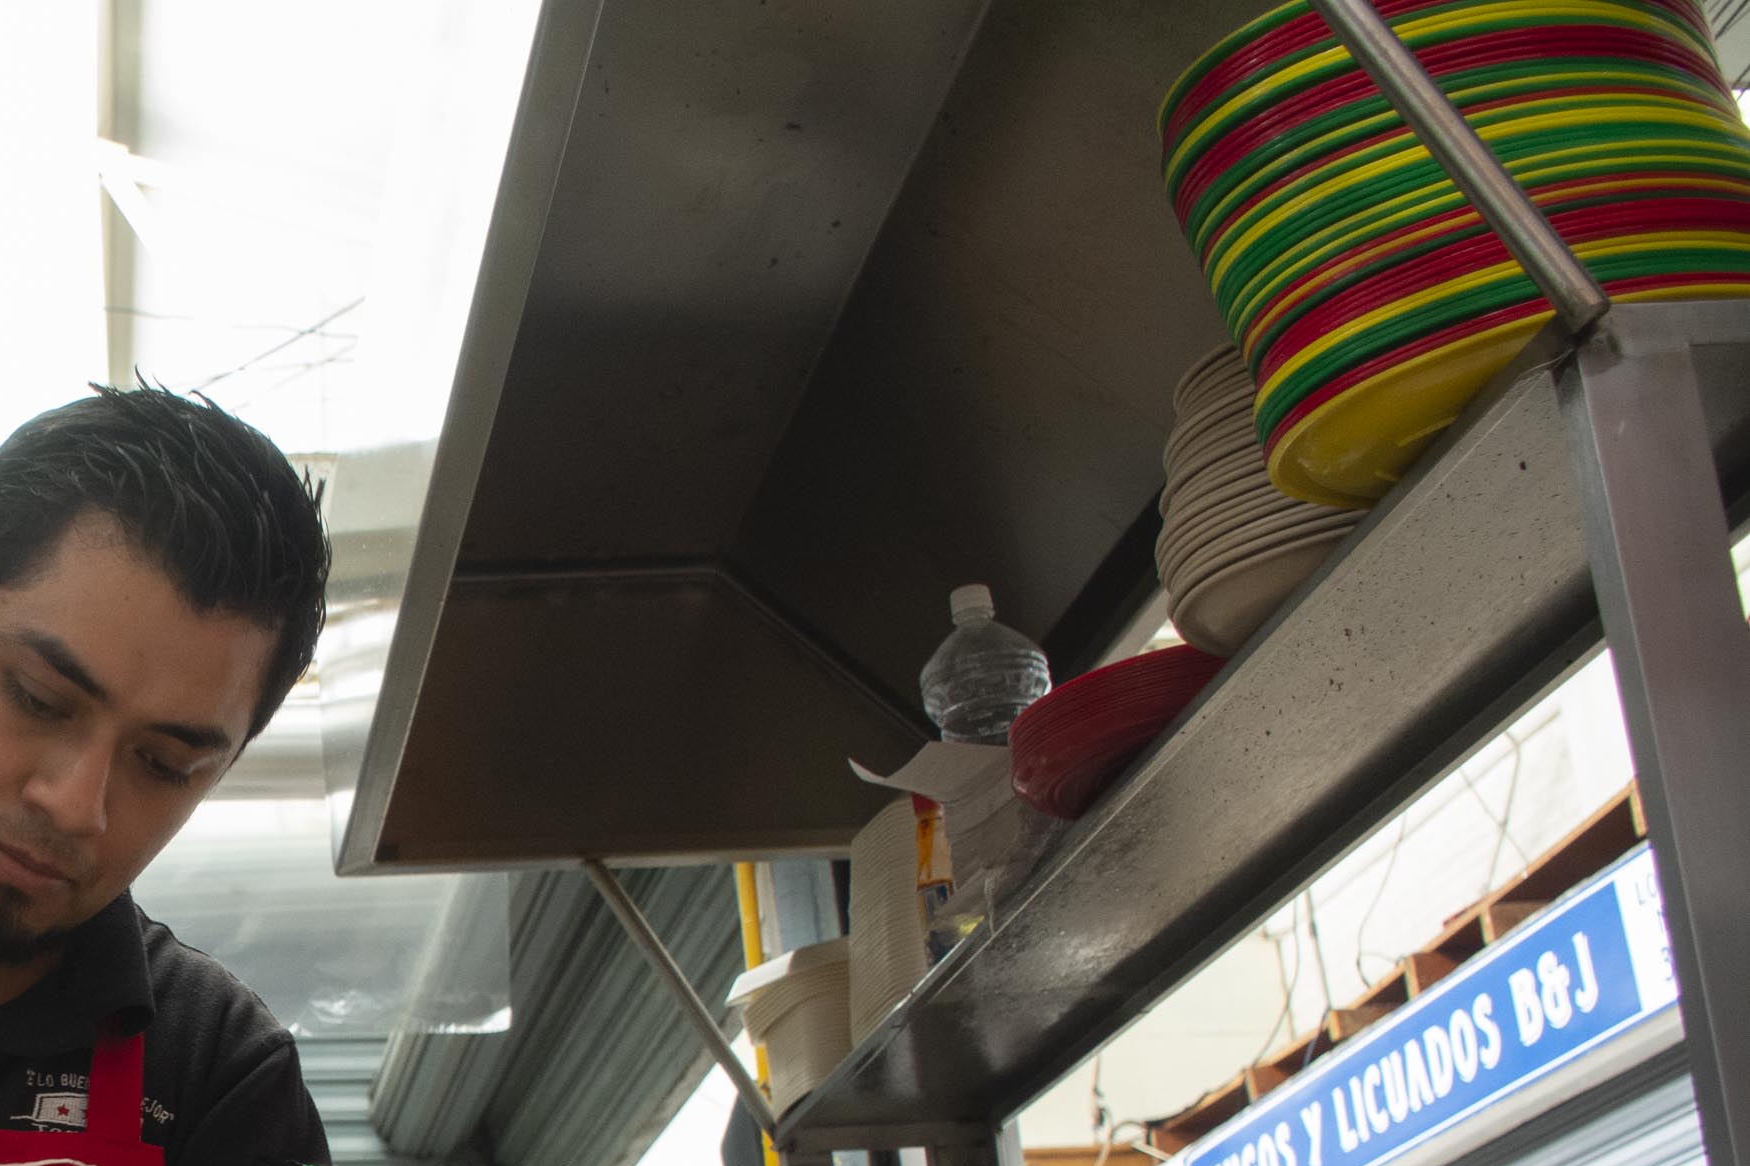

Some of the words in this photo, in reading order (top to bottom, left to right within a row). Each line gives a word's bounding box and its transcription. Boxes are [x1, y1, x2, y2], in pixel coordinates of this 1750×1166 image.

[37, 1073, 55, 1087] LO
[61, 1074, 90, 1089] BUE
[1332, 993, 1501, 1153] LICUADOS
[1508, 931, 1599, 1047] B&J
